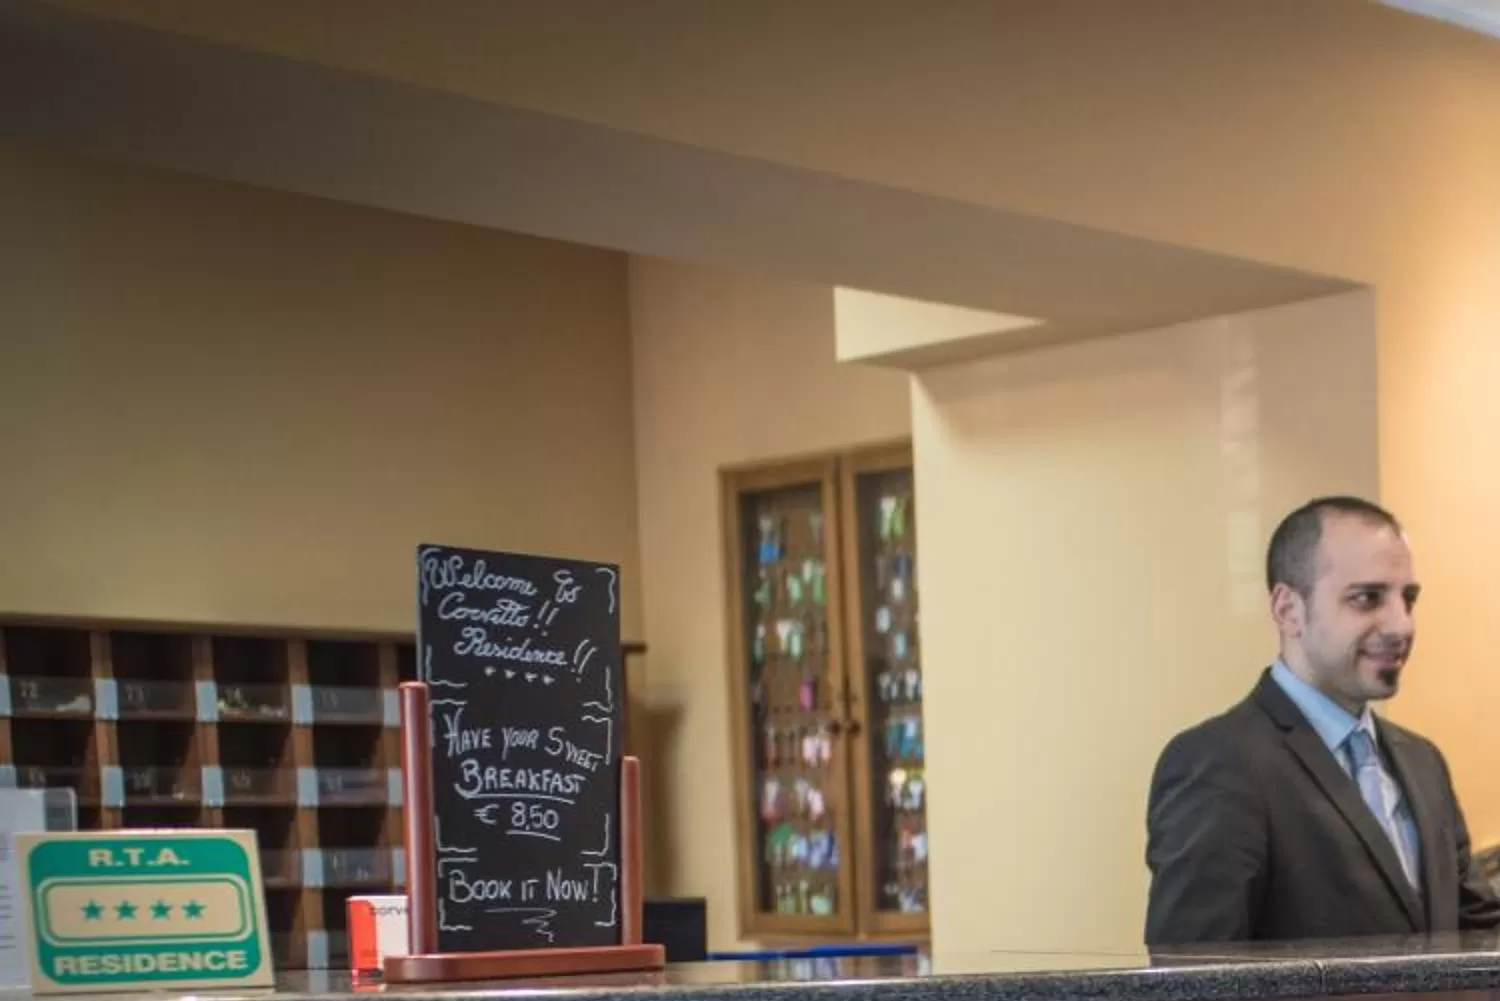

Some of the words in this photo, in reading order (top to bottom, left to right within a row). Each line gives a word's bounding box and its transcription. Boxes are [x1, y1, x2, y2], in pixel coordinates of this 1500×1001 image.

[425, 555, 538, 596] Welcome
[454, 758, 587, 799] BREAKFAST
[88, 848, 191, 868] R.T.A.
[54, 950, 249, 977] RESIDENCE
